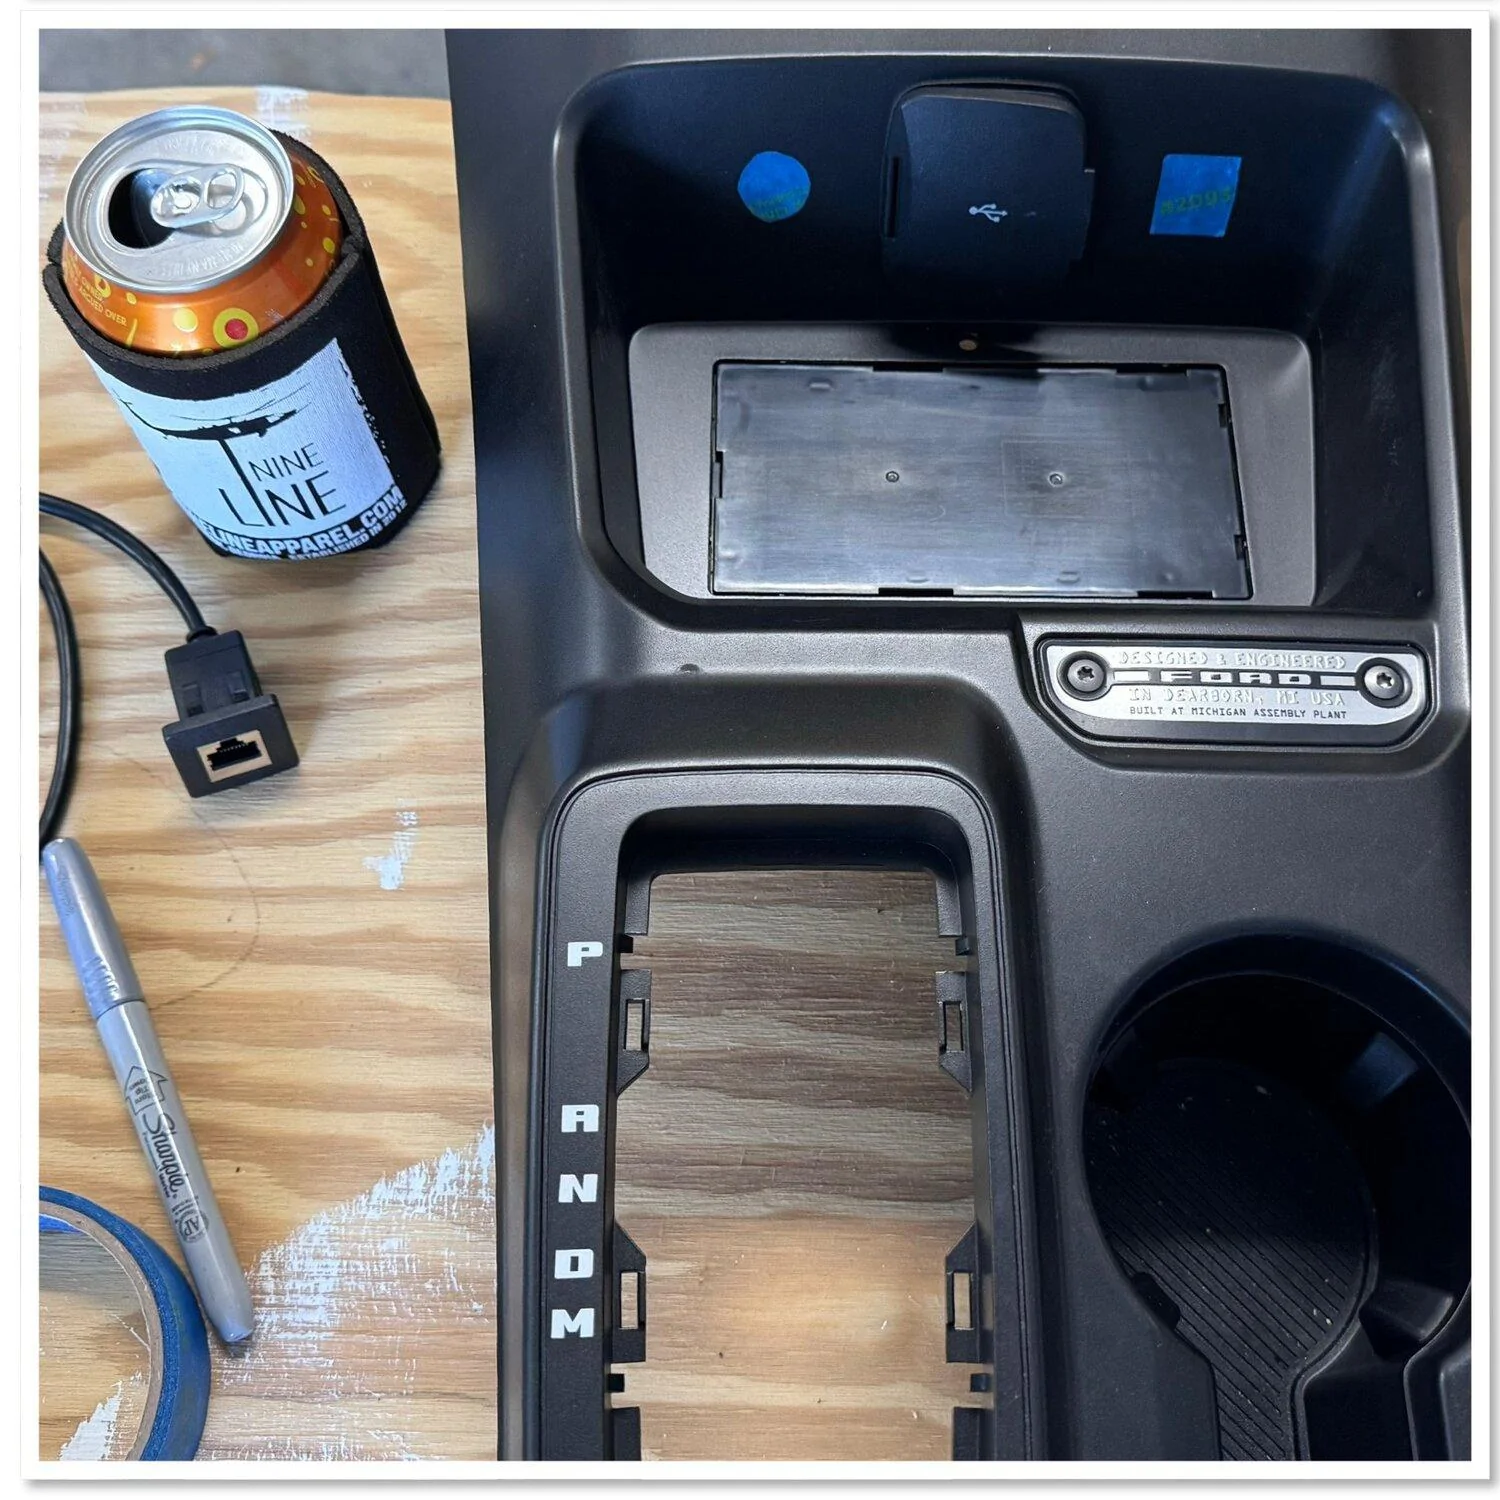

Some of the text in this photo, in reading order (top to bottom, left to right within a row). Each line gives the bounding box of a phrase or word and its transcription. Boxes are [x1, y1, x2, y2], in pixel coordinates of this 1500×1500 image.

[248, 441, 326, 483] NINE
[218, 468, 348, 529] LINE
[1117, 651, 1209, 668] DESIGNED
[1233, 652, 1347, 670] ENGINEERED
[1159, 669, 1312, 686] FORD
[1128, 687, 1346, 706] IN DEARBORN, MI USA
[1129, 707, 1348, 720] BUILT AT MICHIGAN ASSEMBLY PLANT
[566, 940, 604, 967] P
[560, 1103, 601, 1133] A
[557, 1173, 599, 1204] N
[553, 1248, 594, 1280] D
[549, 1307, 595, 1339] M
